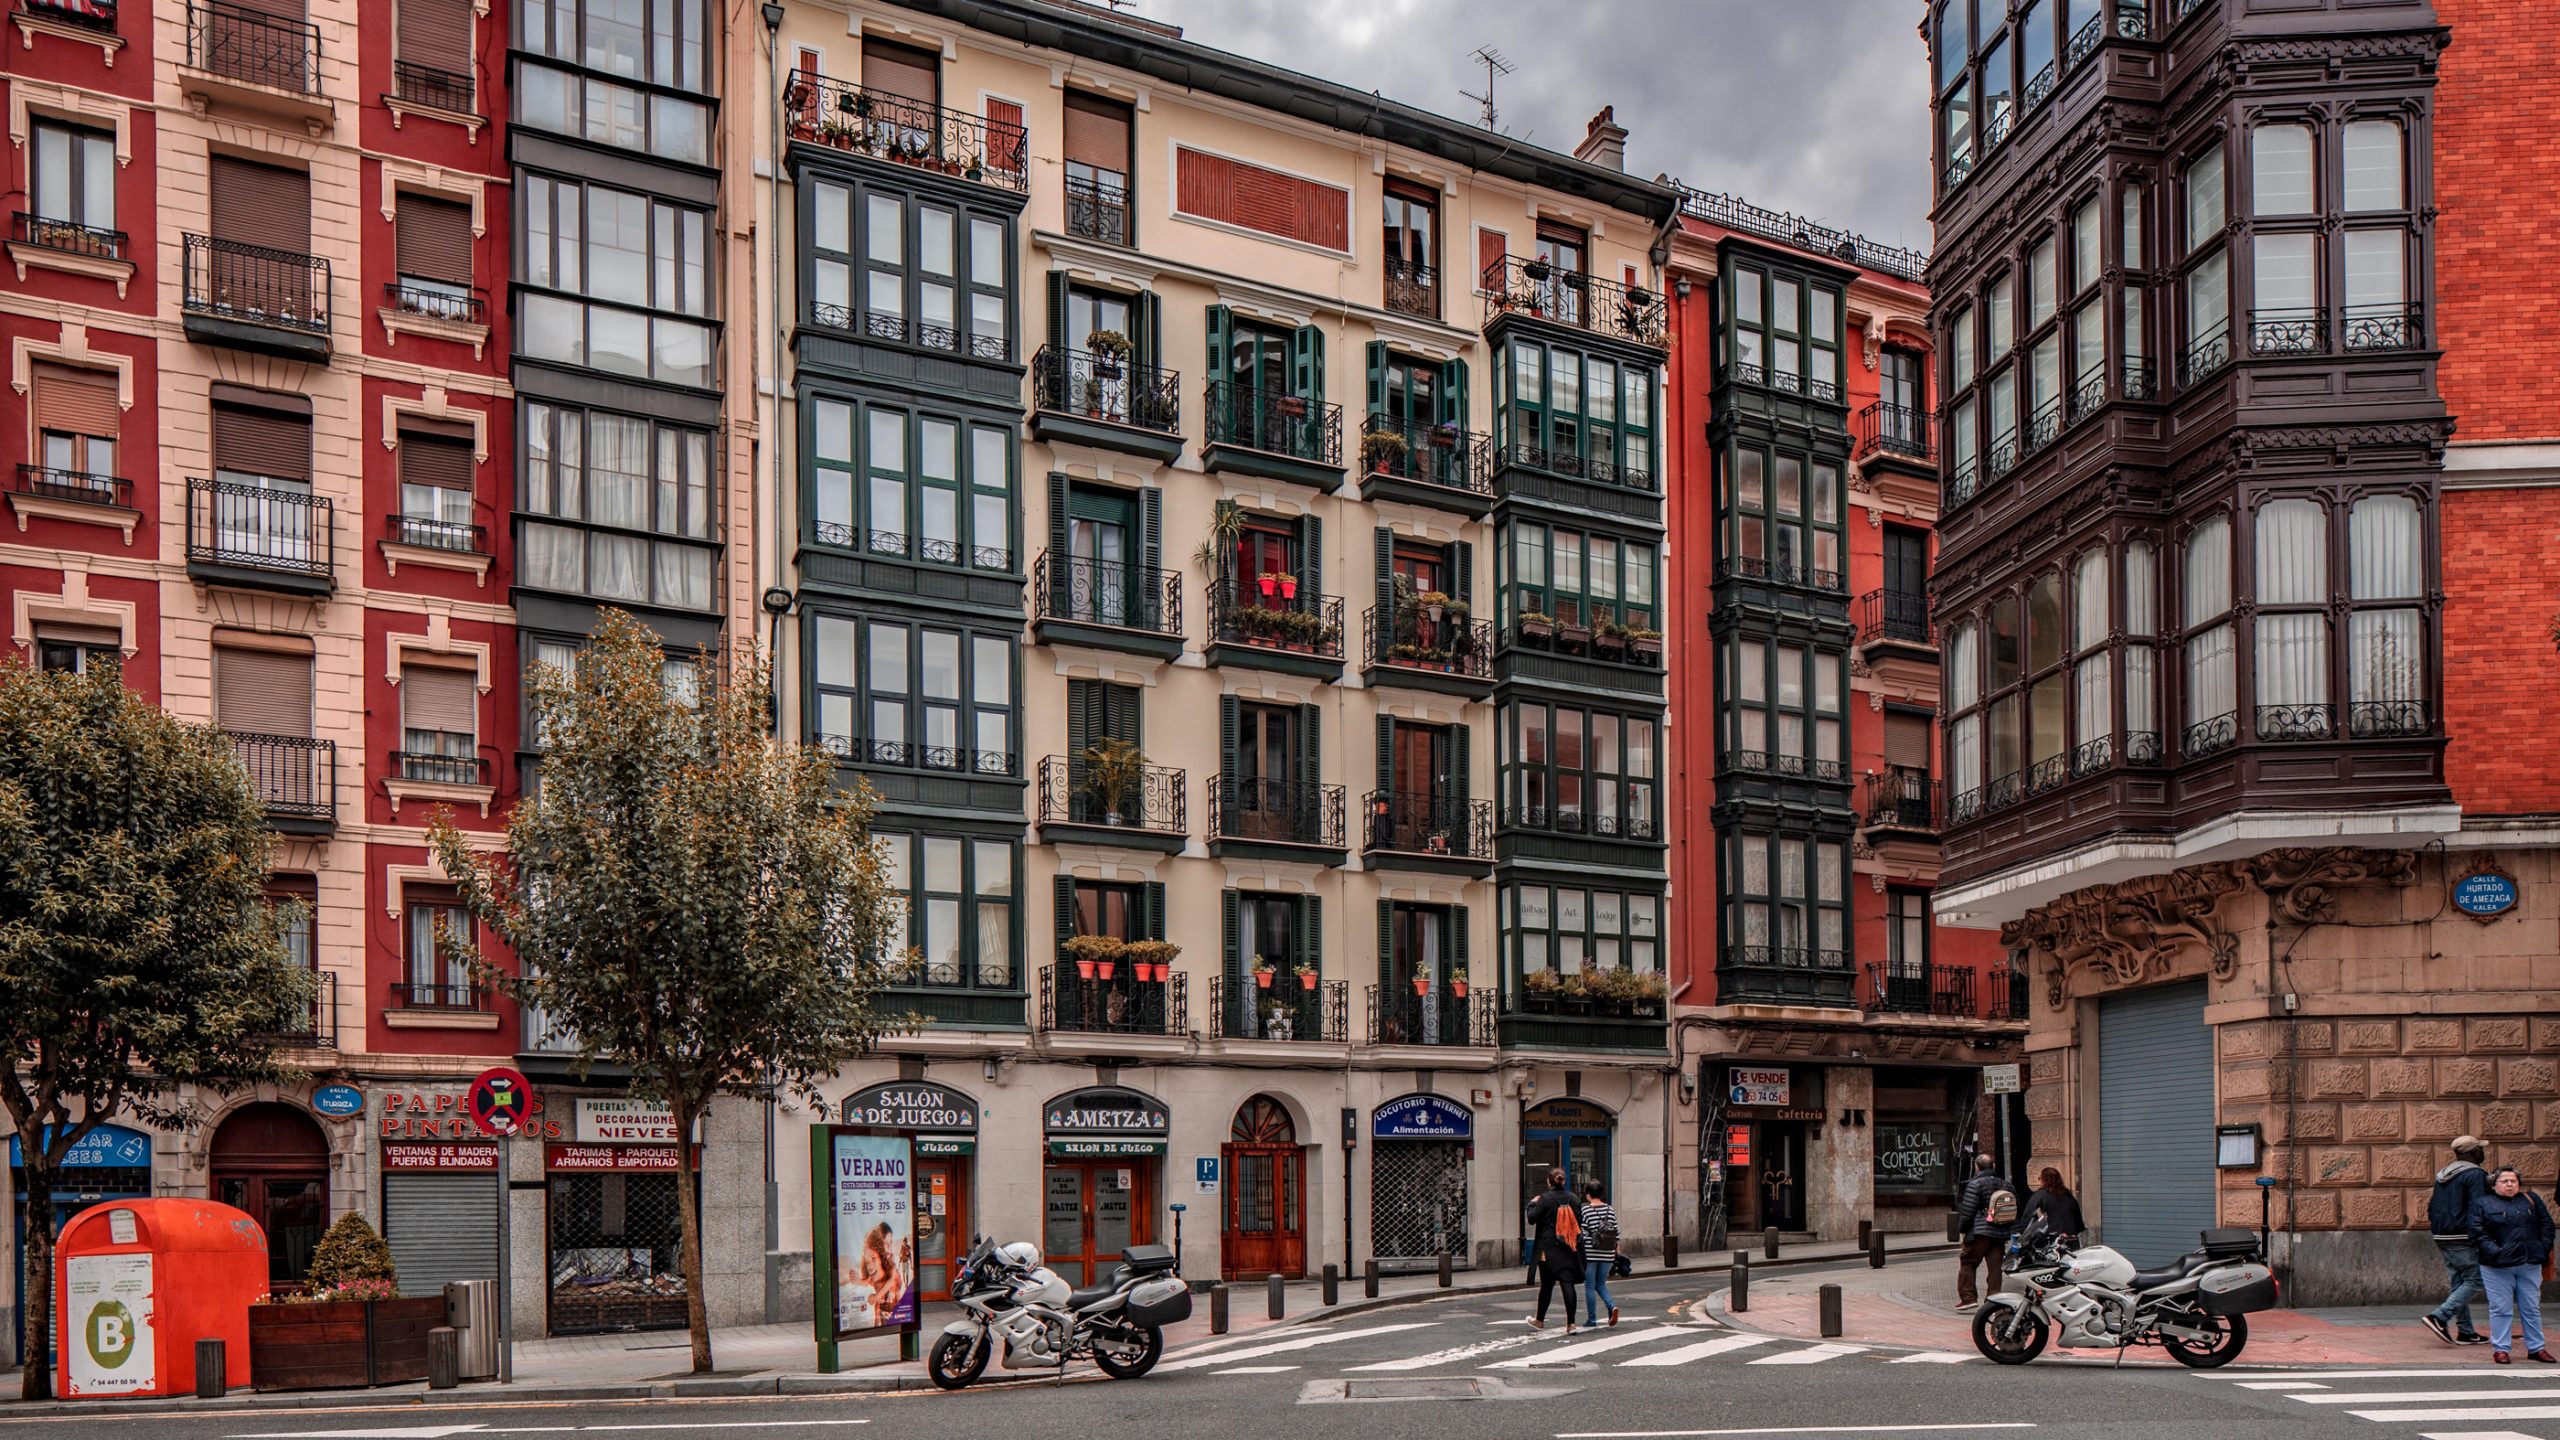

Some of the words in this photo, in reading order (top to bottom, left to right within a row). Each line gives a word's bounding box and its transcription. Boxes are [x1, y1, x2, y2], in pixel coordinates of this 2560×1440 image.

[2467, 884, 2503, 892] HURTADO
[2473, 894, 2511, 903] AMEZAGA
[1521, 905, 1547, 914] Bilbao
[1564, 908, 1577, 917] Art
[1596, 911, 1617, 922] Lodge
[1751, 1073, 1786, 1084] VENDE
[880, 1089, 944, 1107] SALÓN
[1758, 1091, 1767, 1101] 74
[384, 1094, 545, 1113] PAPES
[586, 1102, 627, 1111] PUERTAS
[646, 1103, 670, 1112] MOQU
[1376, 1098, 1426, 1121] LOCUTORIO
[1432, 1099, 1468, 1121] INTERNET
[1549, 1106, 1582, 1117] RAQUEL
[596, 1115, 674, 1124] DECORACIONE
[866, 1108, 892, 1124] DE
[897, 1109, 958, 1125] JUEGO
[1064, 1110, 1151, 1128] AMETZA
[381, 1118, 561, 1138] PINTAOS
[599, 1128, 678, 1138] NIEVES
[1392, 1126, 1454, 1134] Alimentación
[1897, 1131, 1935, 1149] LOCAL
[386, 1147, 437, 1156] VENTANAS
[441, 1147, 455, 1156] DE
[458, 1147, 498, 1156] MADERA
[566, 1148, 613, 1157] TARIMAS
[922, 1143, 959, 1152] JUEGO
[1065, 1144, 1100, 1152] SALON
[1103, 1144, 1117, 1152] DE
[1120, 1144, 1154, 1152] JUEGO
[392, 1157, 436, 1166] PUERTAS
[439, 1157, 493, 1166] BLINDADAS
[555, 1158, 613, 1166] ARMARIOS
[618, 1158, 677, 1166] EMPOTRAD
[1881, 1151, 1945, 1169] COMERCIAL
[841, 1159, 905, 1176] VERANO
[1204, 1160, 1214, 1173] P
[2035, 1273, 2054, 1284] 092
[98, 1316, 126, 1352] B
